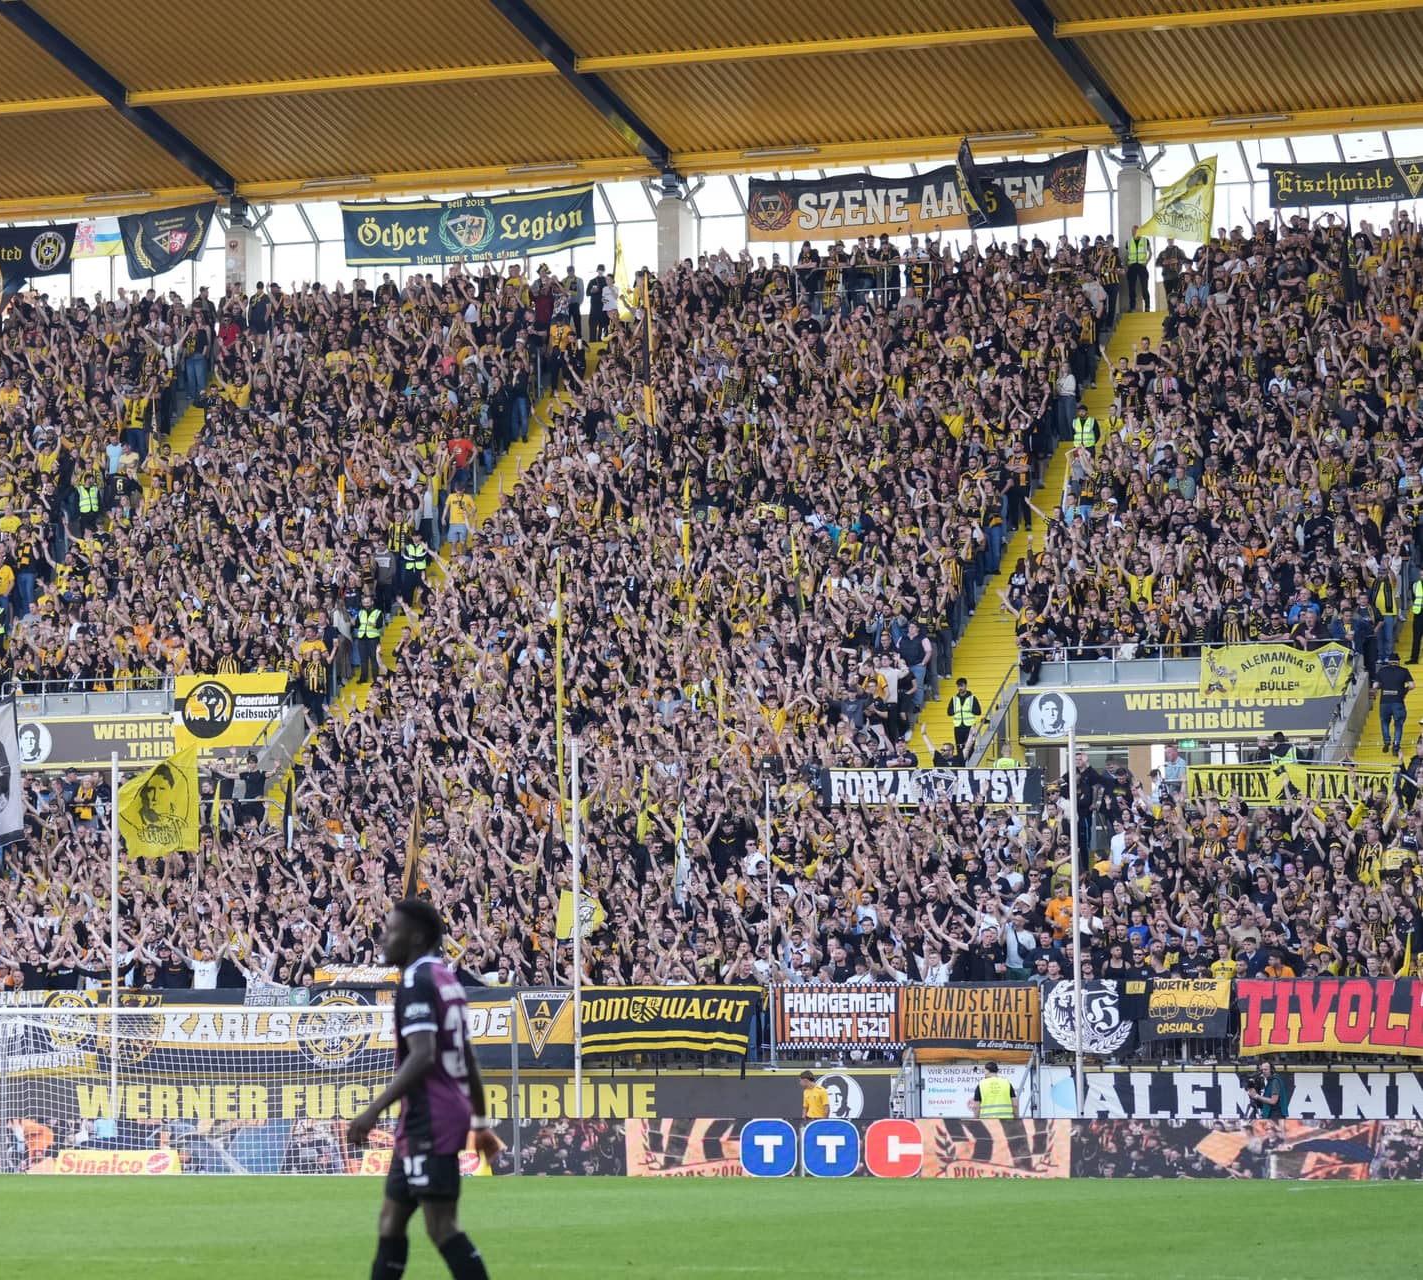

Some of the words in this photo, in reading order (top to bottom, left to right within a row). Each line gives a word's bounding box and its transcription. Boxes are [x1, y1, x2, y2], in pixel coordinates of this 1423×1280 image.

[797, 188, 909, 230] SZENE
[357, 217, 429, 251] Öcher
[500, 208, 583, 241] Legion
[1270, 665, 1285, 675] AU
[235, 695, 279, 705] Generation
[1125, 693, 1221, 710] WERNER
[1165, 709, 1266, 730] TRIBÜNE
[94, 724, 175, 740] WERNER
[830, 770, 914, 805] FORZA
[1191, 772, 1270, 798] AACHEN
[523, 989, 567, 999] ALEMANNIA
[1193, 981, 1217, 991] SIDE
[905, 986, 1032, 1013] FREUNDSCHAFT
[660, 999, 750, 1023] WACHT
[161, 1010, 291, 1044] KARLS
[790, 1017, 852, 1037] SCHAFT
[857, 1017, 890, 1037] 520
[905, 1013, 1033, 1040] ZUSAMMENHALT
[1157, 1022, 1204, 1034] CASUALS
[77, 1085, 268, 1119] WERNER
[59, 1153, 143, 1174] Sinalco
